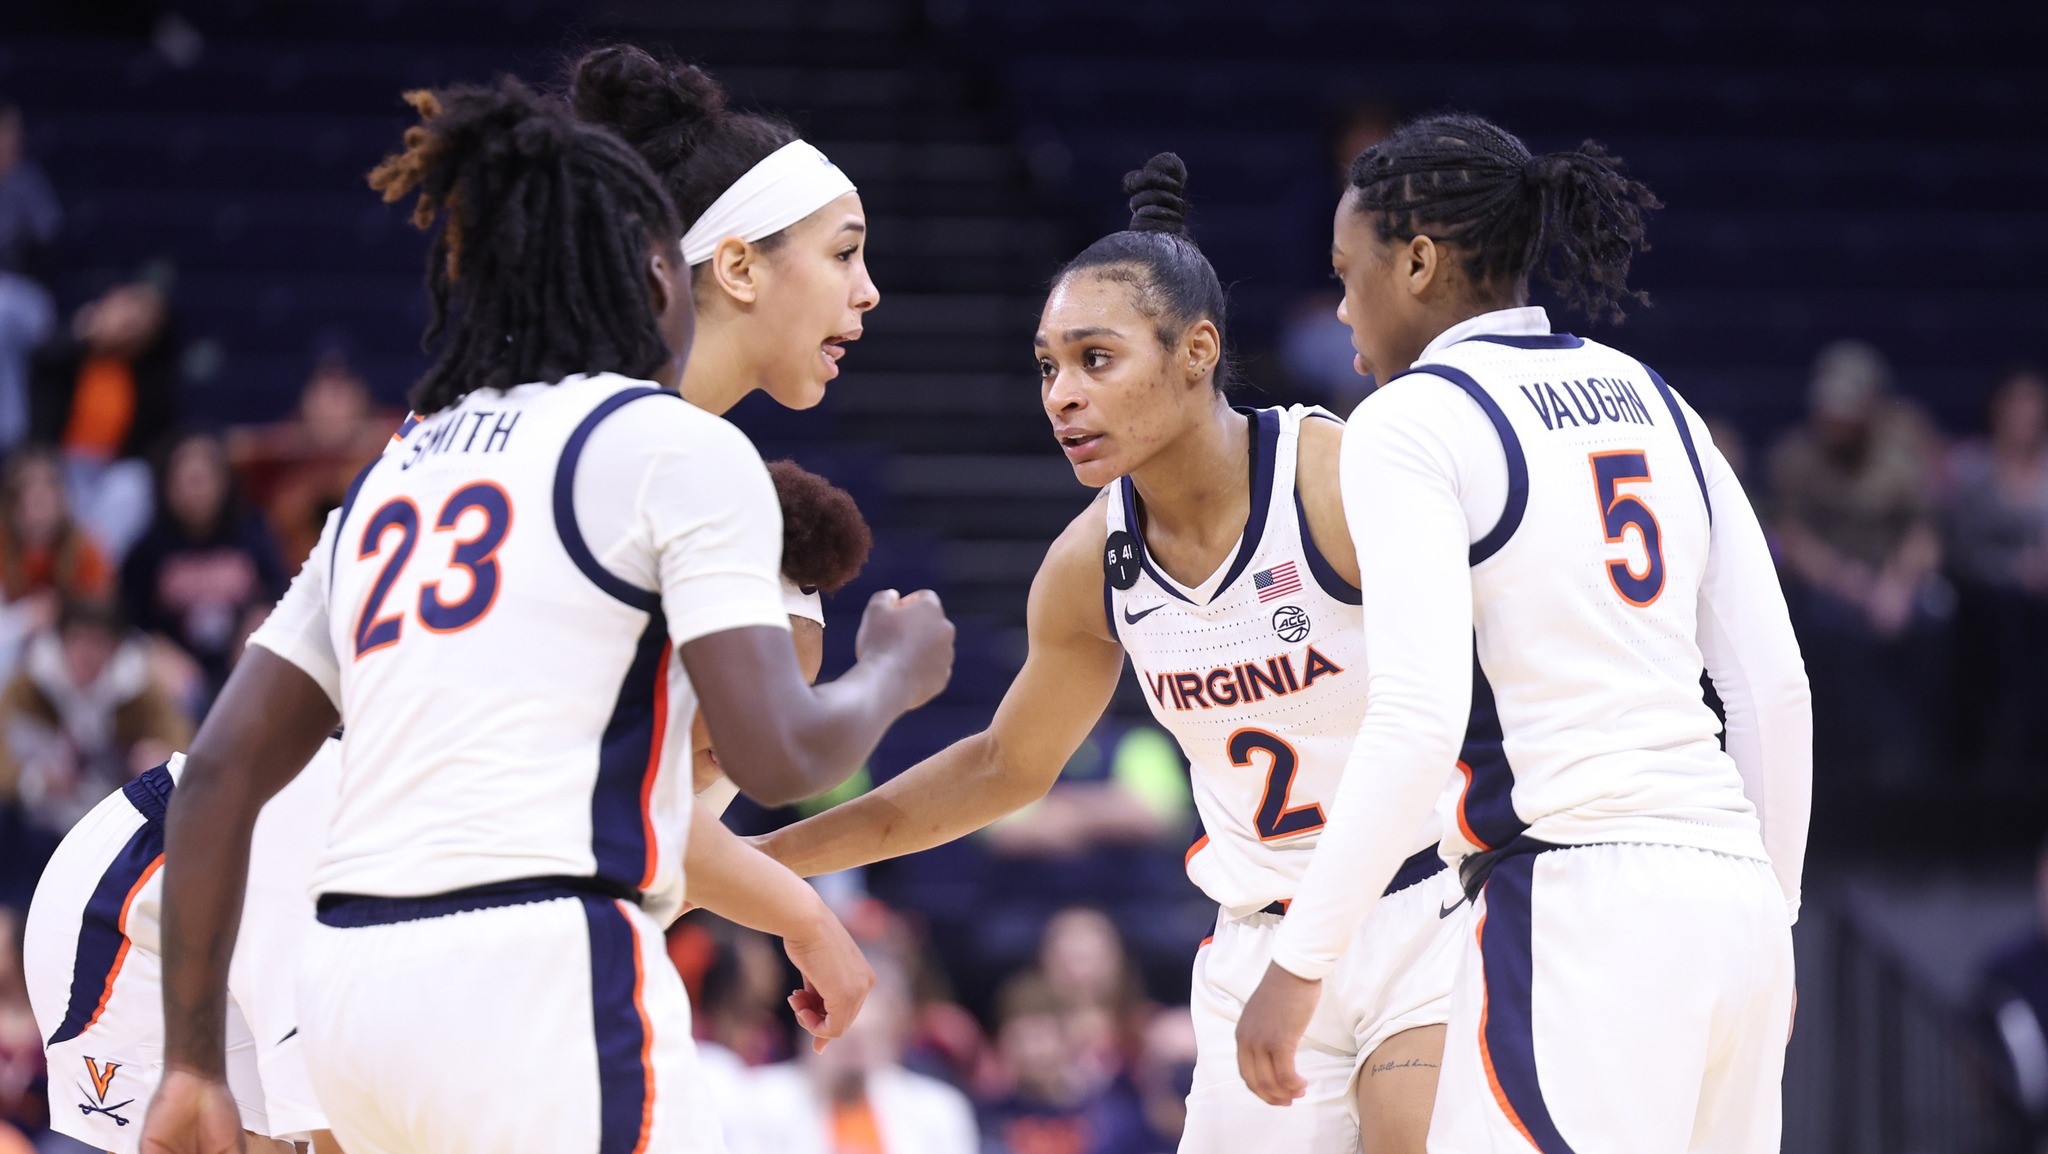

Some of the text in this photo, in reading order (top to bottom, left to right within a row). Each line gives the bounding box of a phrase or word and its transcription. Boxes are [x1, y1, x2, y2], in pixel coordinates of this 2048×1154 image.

[1518, 377, 1655, 431] VAUGHN
[401, 410, 522, 471] SMITH
[1107, 543, 1133, 566] 15 41
[1587, 448, 1667, 608] 5
[354, 478, 514, 663] 23
[1279, 612, 1307, 629] ACC
[1144, 643, 1344, 711] VIRGINIA
[1226, 727, 1328, 841] 2
